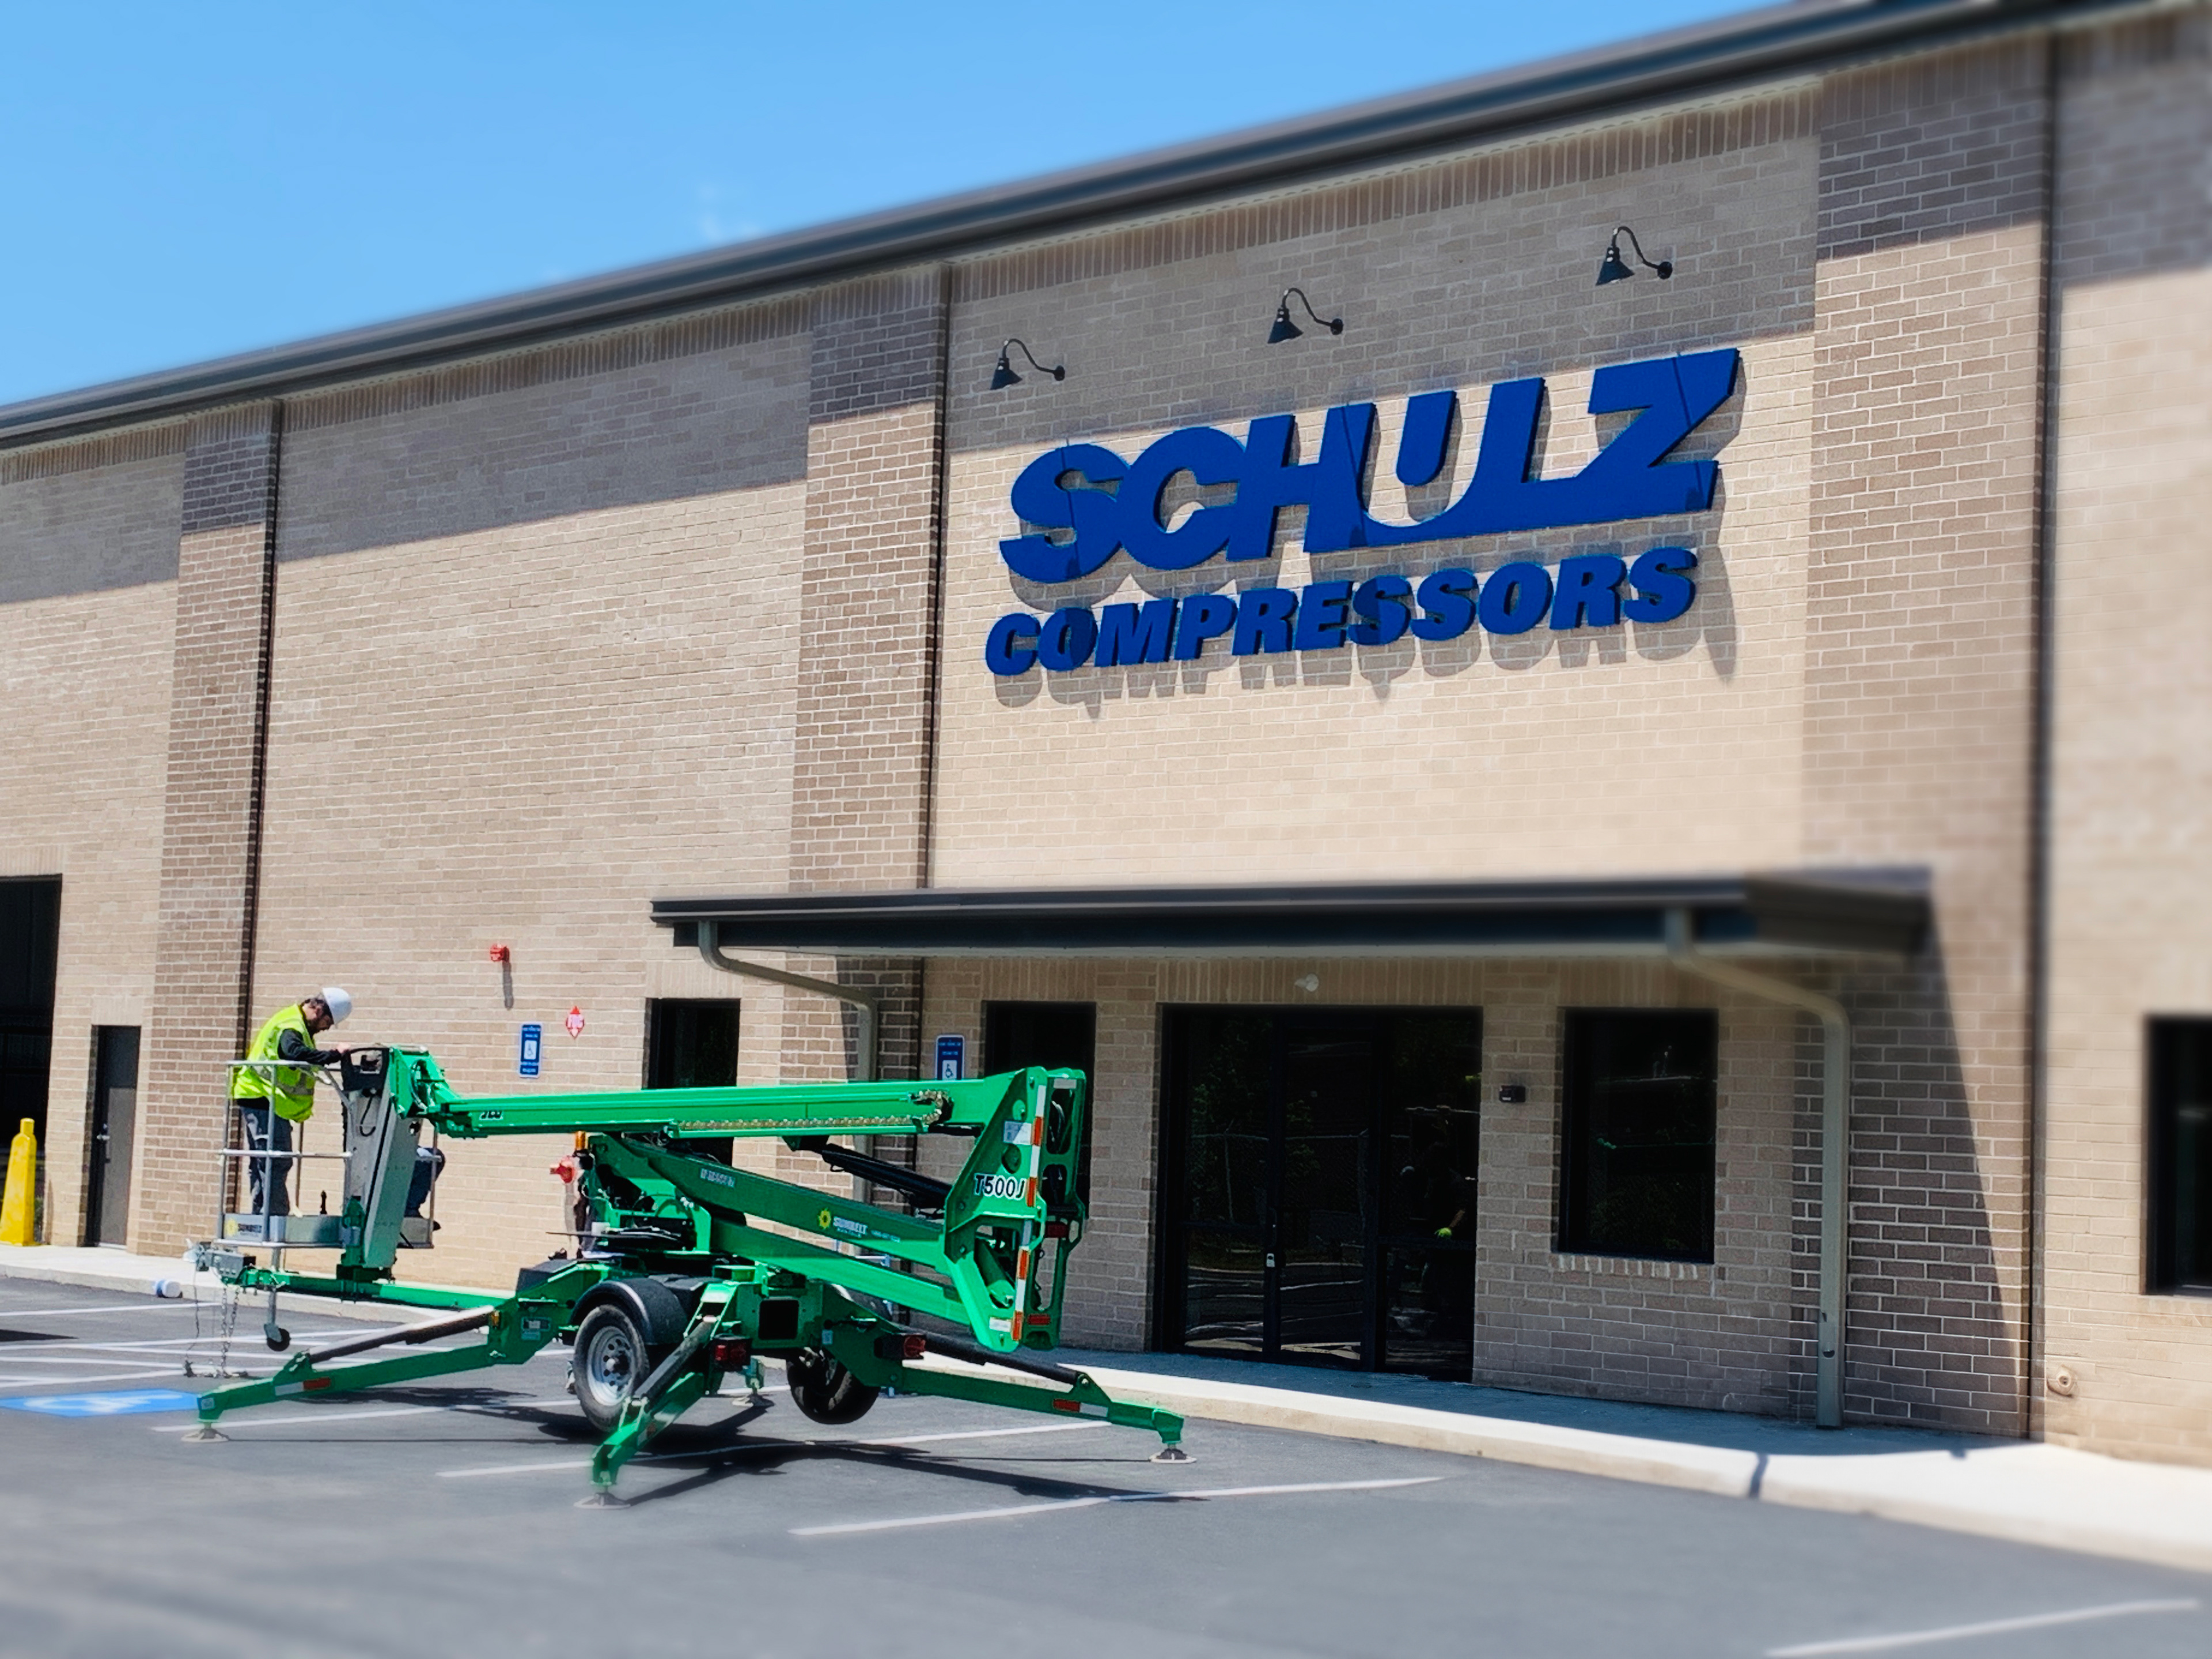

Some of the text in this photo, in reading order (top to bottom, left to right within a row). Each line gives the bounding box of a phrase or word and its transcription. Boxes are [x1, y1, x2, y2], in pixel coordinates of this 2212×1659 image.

[999, 347, 1739, 584] SCHULZ
[985, 545, 1697, 676] COMPRESSORS
[975, 1173, 1027, 1200] T500J
